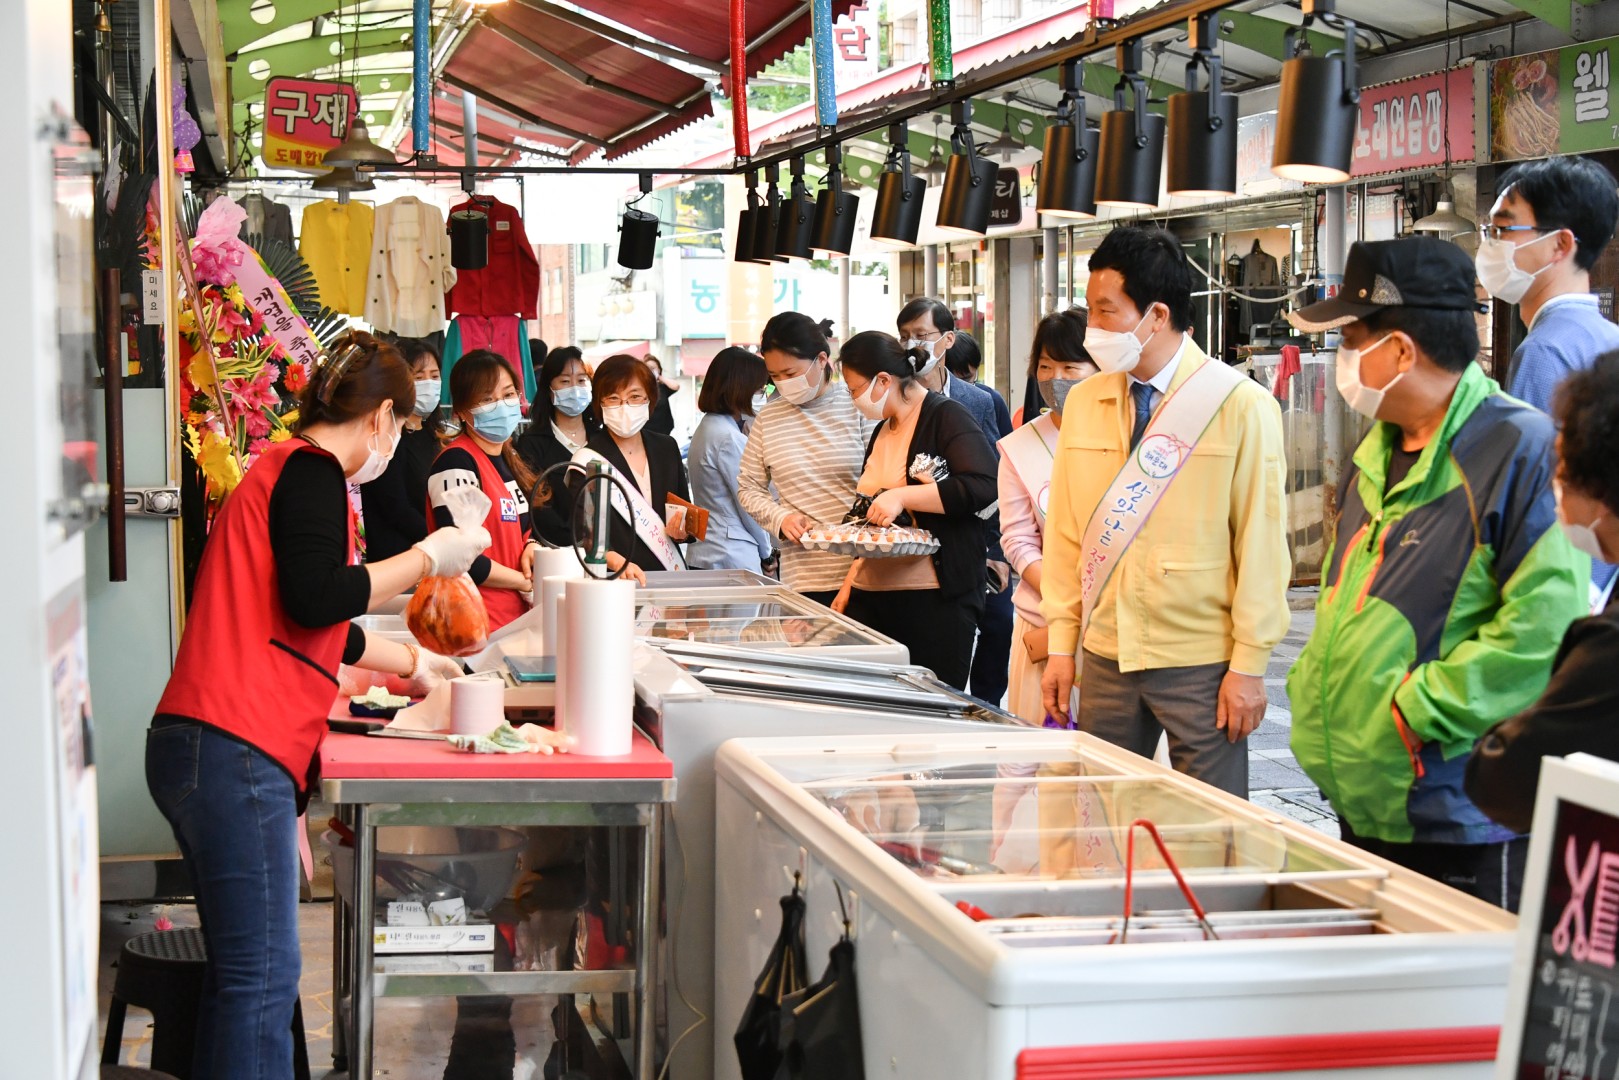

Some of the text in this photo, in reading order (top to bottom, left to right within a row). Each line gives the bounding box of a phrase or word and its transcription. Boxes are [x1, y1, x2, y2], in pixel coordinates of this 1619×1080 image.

[272, 89, 349, 138] 구제
[274, 148, 323, 167] 도매합
[253, 286, 295, 332] 개업을
